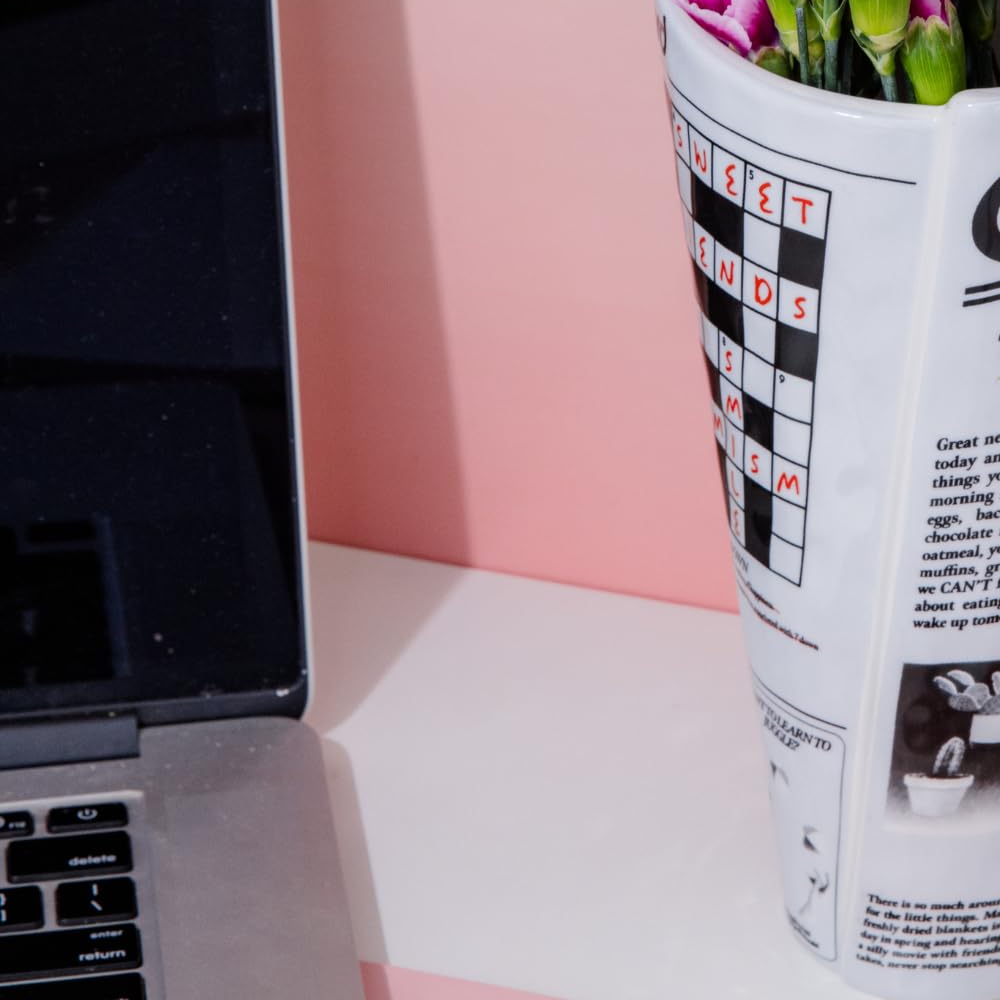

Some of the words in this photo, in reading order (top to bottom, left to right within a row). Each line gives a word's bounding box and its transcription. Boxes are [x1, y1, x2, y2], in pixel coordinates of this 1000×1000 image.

[936, 437, 979, 451] Great
[935, 455, 978, 471] today
[932, 475, 980, 489] things
[929, 491, 994, 506] morning
[927, 514, 962, 529] eggs,
[925, 528, 993, 543] chocolate
[922, 545, 983, 561] oatmeal,
[920, 564, 978, 577] muffins,
[918, 586, 935, 594] we
[941, 579, 993, 594] CAN'T
[915, 600, 954, 612] about
[913, 617, 946, 628] wake
[951, 619, 968, 630] up
[814, 736, 832, 752] TO
[68, 854, 117, 867] delete
[868, 894, 898, 908] There
[902, 900, 911, 909] is
[930, 901, 965, 910] much
[866, 906, 880, 917] for
[884, 911, 901, 919] the
[904, 912, 933, 922] little
[863, 918, 898, 934] freshly
[902, 924, 932, 935] dried
[936, 924, 989, 935] blankets
[90, 929, 123, 939] enter
[881, 936, 891, 944] in
[894, 938, 931, 949] spring
[933, 937, 957, 947] and
[78, 950, 126, 962] return
[930, 949, 958, 958] with
[921, 963, 947, 972] stop
